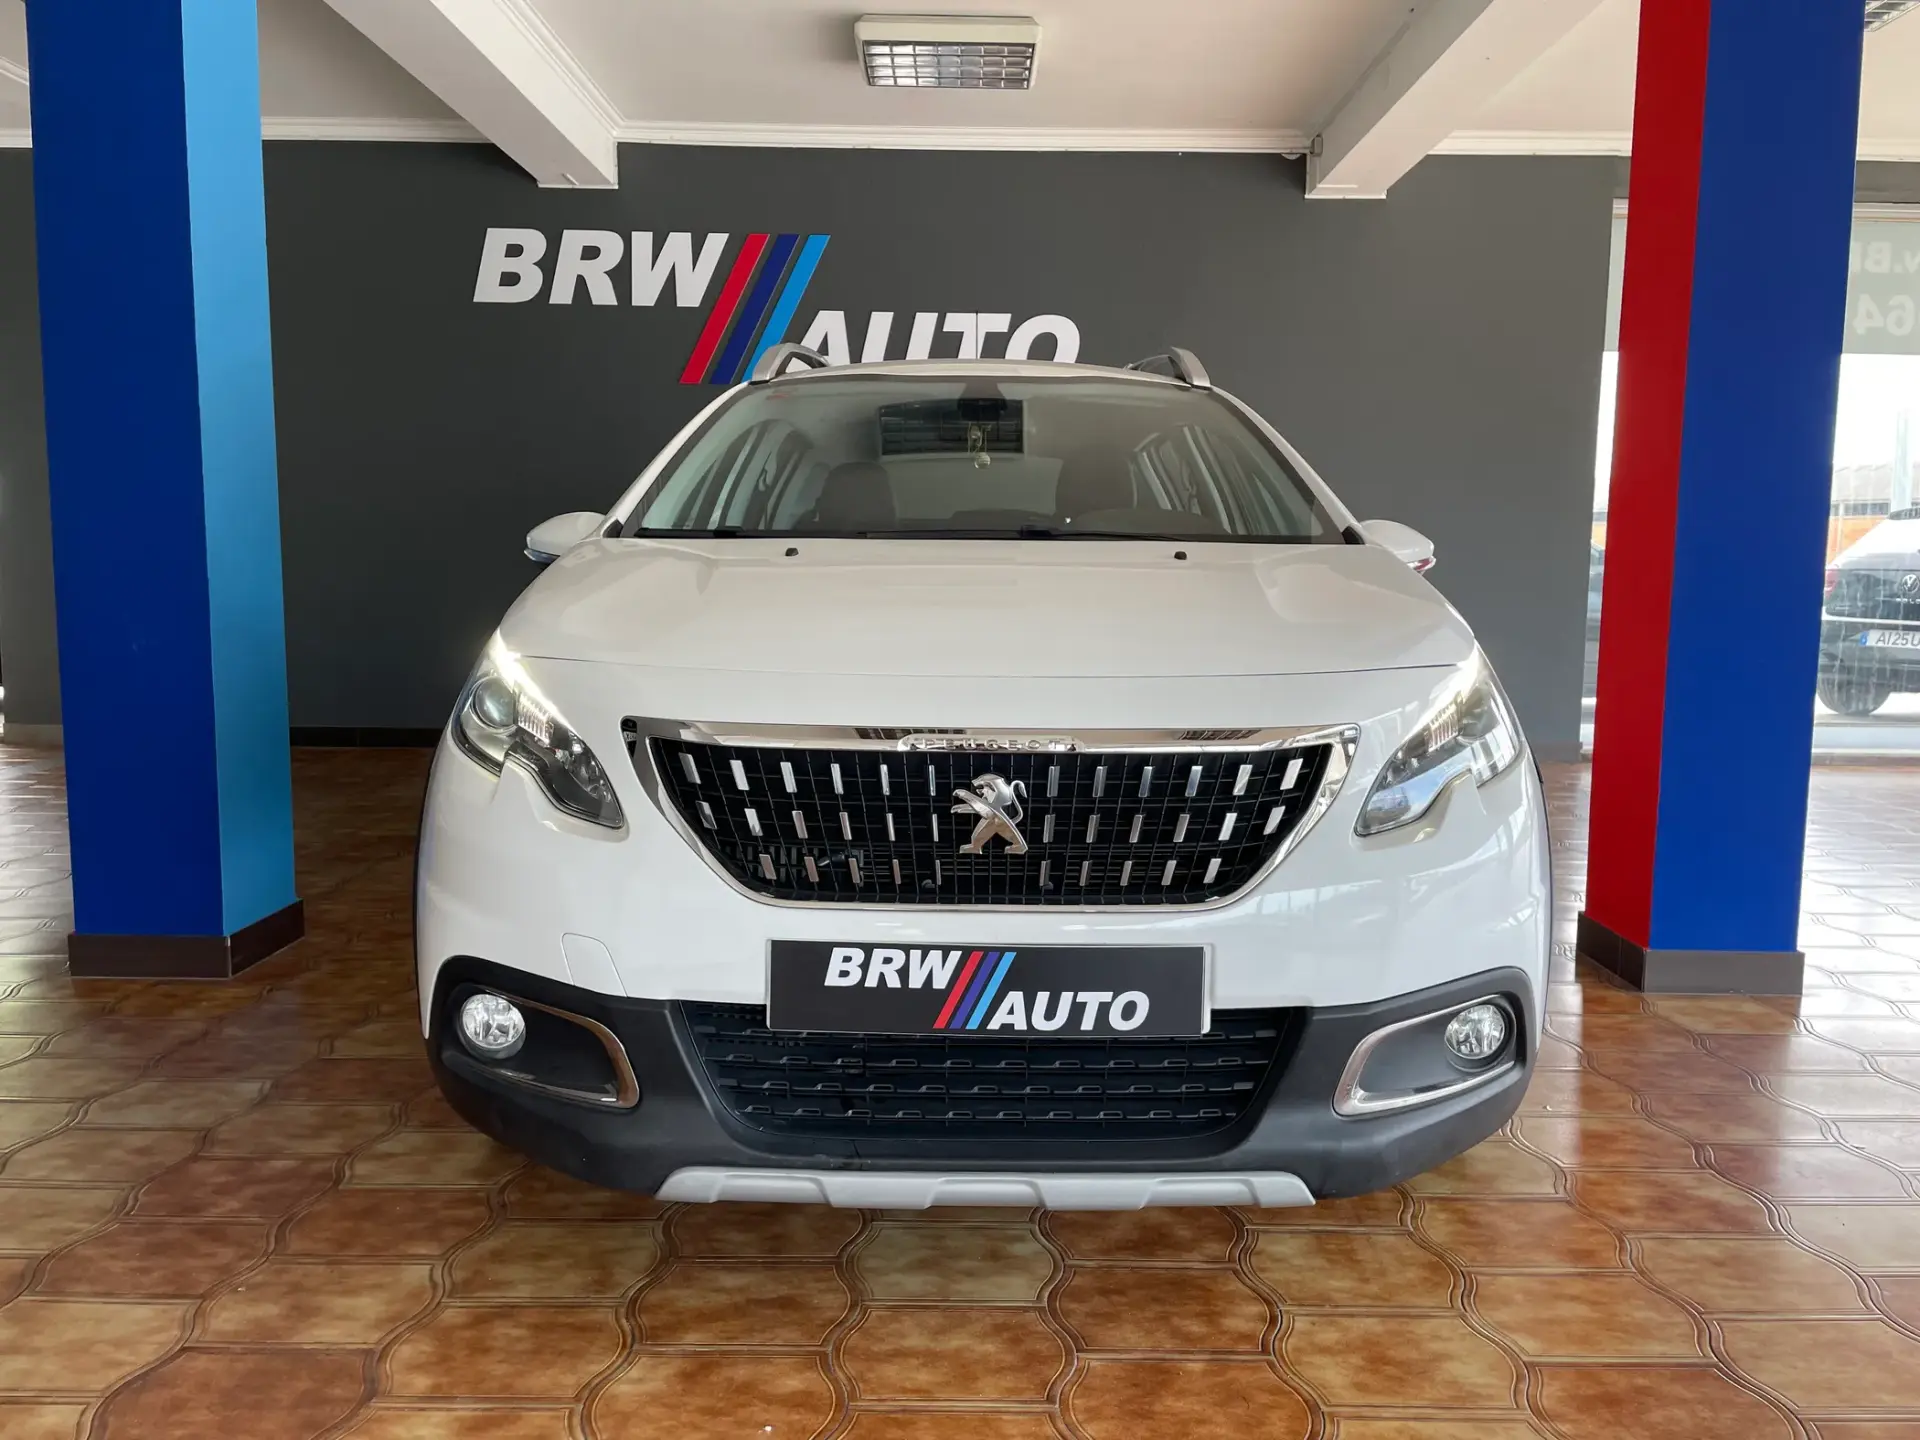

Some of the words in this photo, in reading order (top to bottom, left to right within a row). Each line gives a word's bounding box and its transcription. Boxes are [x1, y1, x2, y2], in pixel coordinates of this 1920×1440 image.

[473, 228, 729, 307] BRW
[785, 310, 1081, 373] AUTO
[922, 738, 1061, 750] PEUGEOT
[824, 947, 962, 989] BRW
[986, 990, 1150, 1030] AUTO
